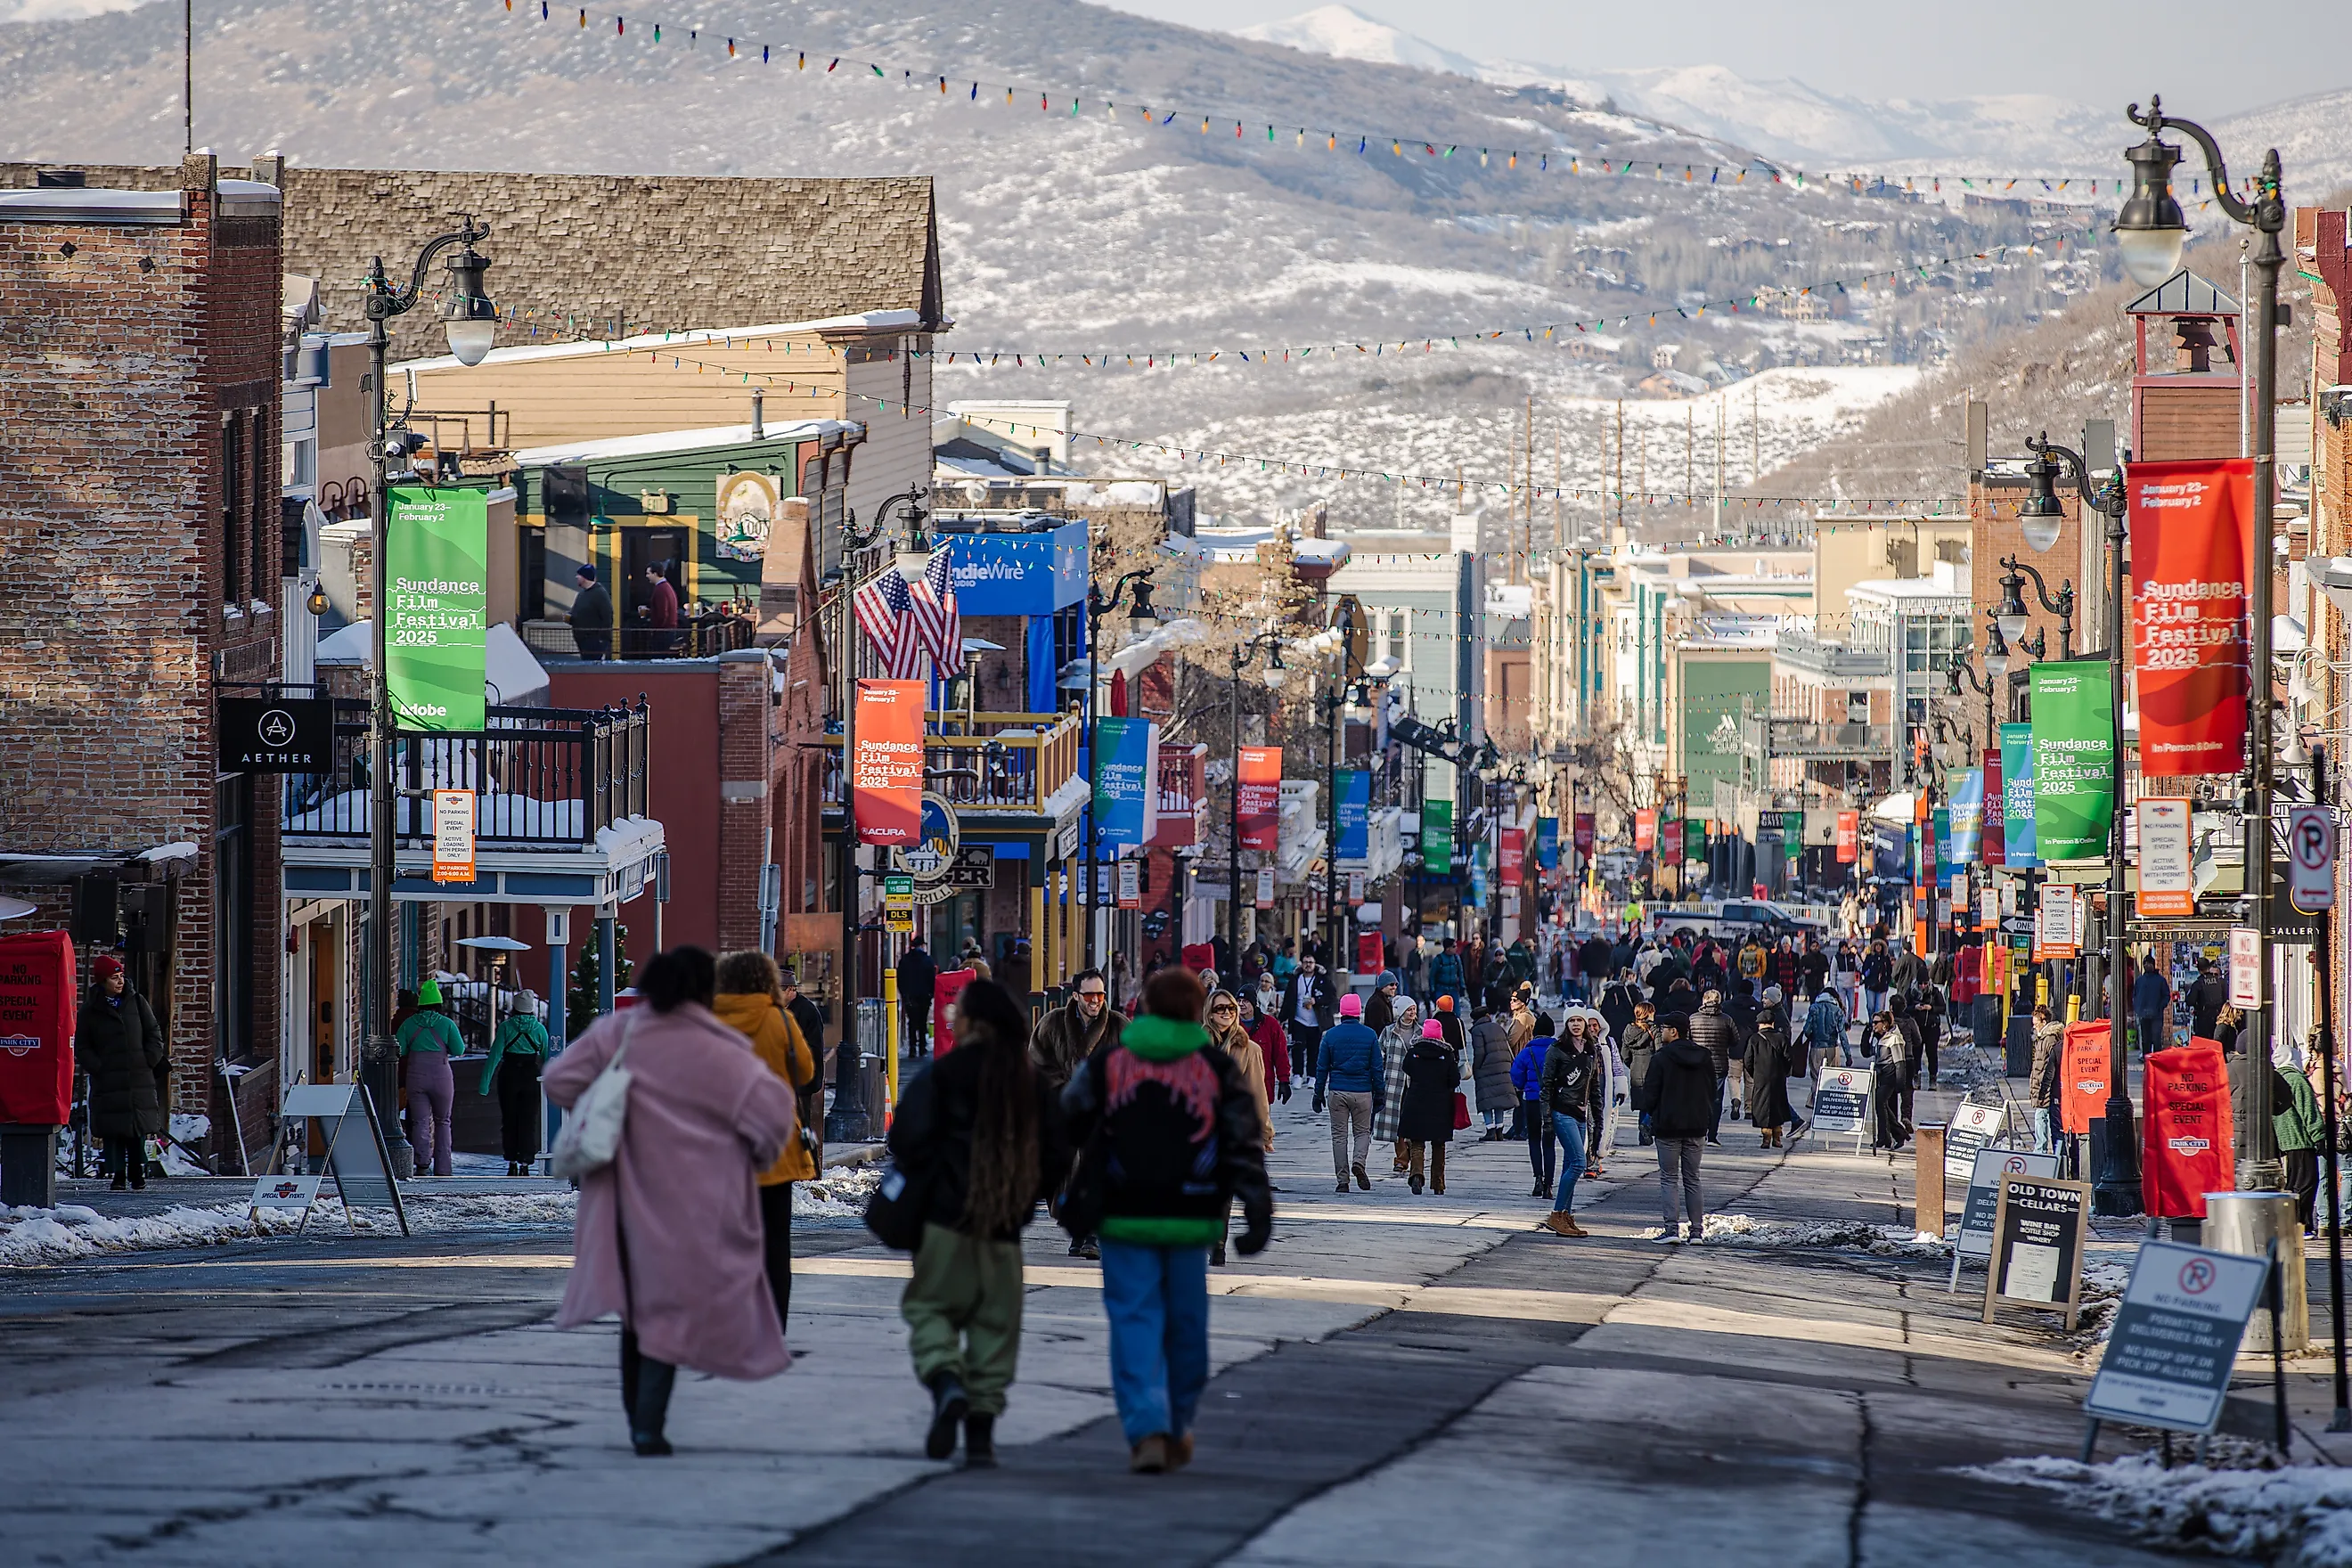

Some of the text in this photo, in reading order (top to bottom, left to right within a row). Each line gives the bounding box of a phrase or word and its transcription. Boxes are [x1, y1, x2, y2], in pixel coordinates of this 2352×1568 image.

[2141, 484, 2186, 495] January
[399, 503, 433, 511] January
[2141, 495, 2201, 508] February 2
[399, 513, 437, 522] February
[396, 577, 479, 592] Sundance
[2143, 579, 2243, 597] Sundance
[396, 595, 437, 608] Film
[2144, 603, 2199, 618] Film
[396, 613, 478, 626] Festival
[396, 631, 437, 643] 2025
[2145, 625, 2239, 642] Festival
[2147, 648, 2200, 665] 2025
[861, 739, 918, 751] Sundance
[2040, 739, 2107, 749] Sundance
[2152, 744, 2162, 752] In
[2163, 743, 2196, 752] Person
[241, 753, 311, 763] AETHER
[861, 752, 889, 763] Film
[2041, 754, 2075, 764] Film
[861, 764, 917, 775] Festival
[2041, 767, 2106, 778] Festival
[861, 776, 889, 786] 2025
[2042, 781, 2075, 792] 2025
[2008, 789, 2033, 797] Film
[2009, 810, 2033, 818] 2025
[867, 828, 906, 836] ACURA
[891, 911, 908, 919] DLS
[2016, 921, 2031, 929] ONE
[2136, 931, 2172, 941] IRISH
[2177, 930, 2204, 940] PUB
[2209, 931, 2217, 940] &
[2241, 938, 2251, 951] NO
[2234, 953, 2258, 968] PARKING
[12, 964, 27, 974] NO
[2242, 970, 2251, 979] ANY
[2239, 981, 2252, 992] TIME
[0, 996, 39, 1007] SPECIAL
[3, 1010, 34, 1020] EVENT
[1566, 1066, 1579, 1081] NIKE
[2181, 1074, 2193, 1082] NO
[2168, 1083, 2207, 1092] PARKING
[2168, 1102, 2206, 1111] SPECIAL
[2174, 1115, 2202, 1123] EVENT
[2008, 1183, 2081, 1202] OLD TOWN
[2019, 1198, 2067, 1213] CELLARS
[2020, 1219, 2061, 1231] WINE BAR
[2020, 1226, 2060, 1237] BOTTLE SHOP
[2026, 1235, 2052, 1244] WINERY
[2154, 1294, 2221, 1312] NO PARKING
[2149, 1313, 2213, 1333] PERMITTED
[2128, 1324, 2224, 1348] DELIVERIES ONLY
[2123, 1344, 2215, 1369] NO DROP OFF OR
[2116, 1356, 2214, 1380] PICK UP ALLOWED
